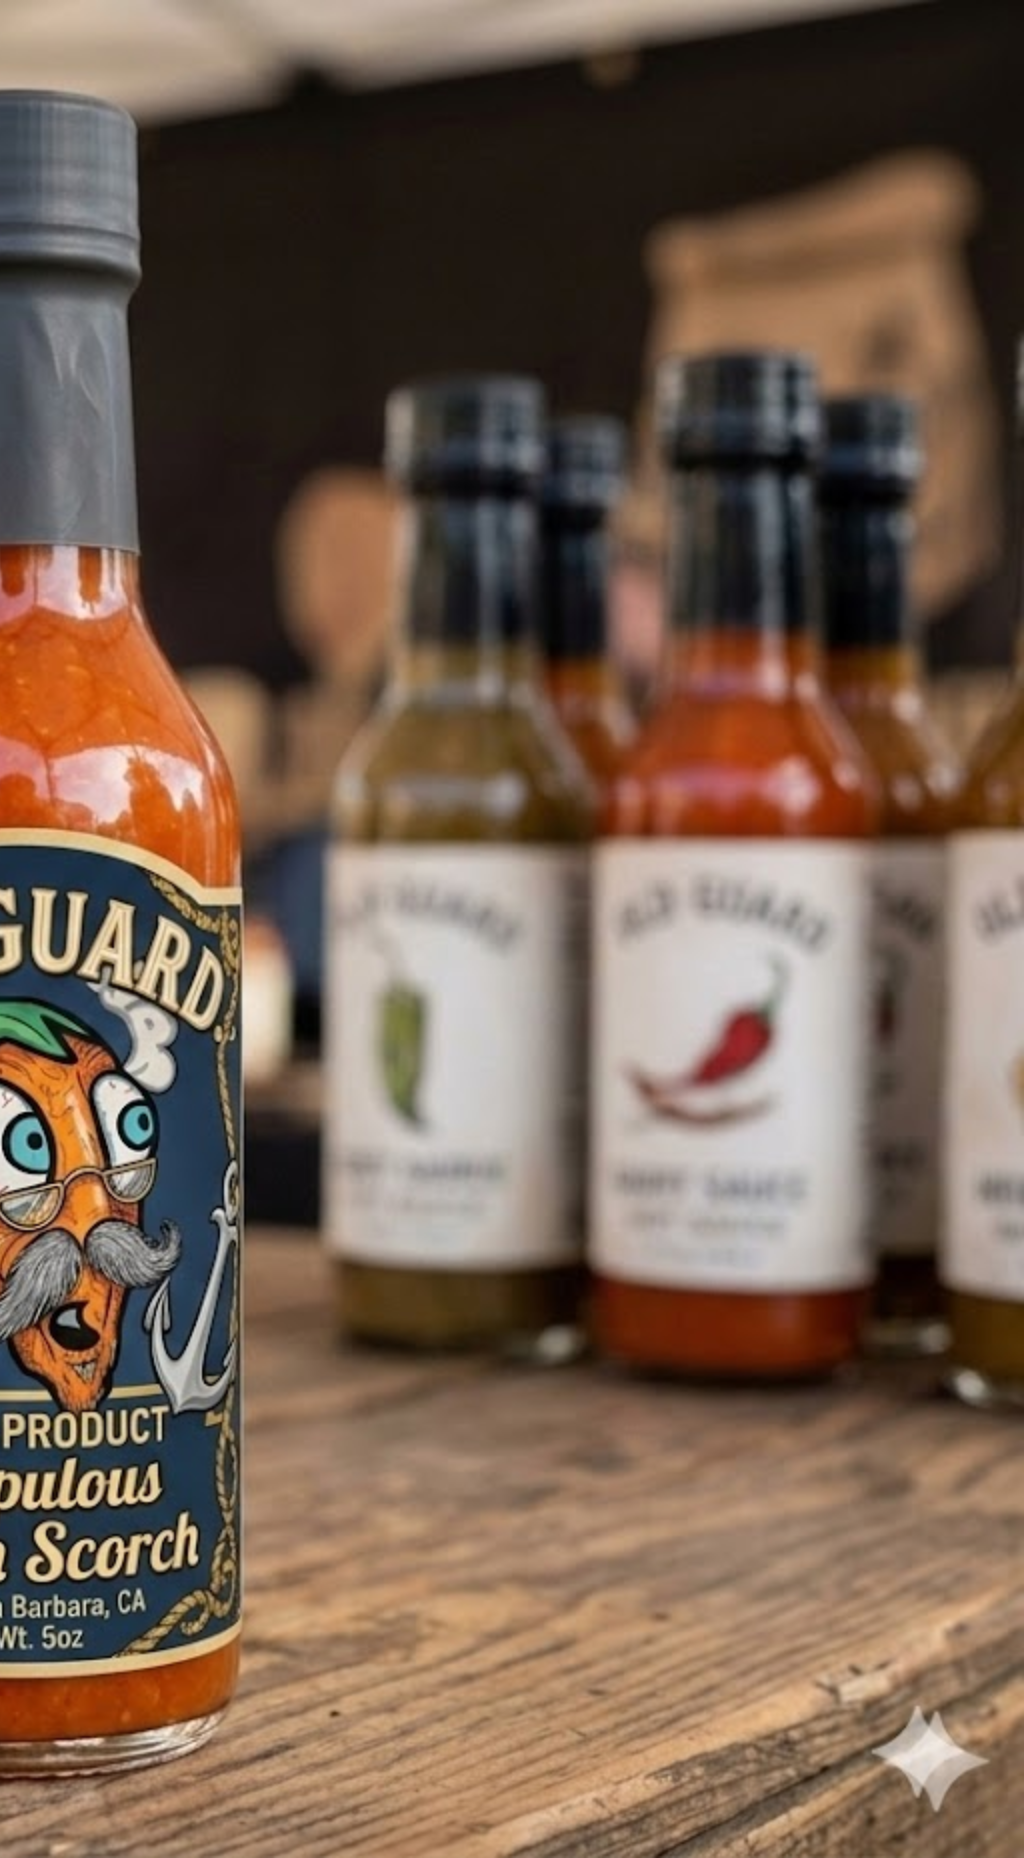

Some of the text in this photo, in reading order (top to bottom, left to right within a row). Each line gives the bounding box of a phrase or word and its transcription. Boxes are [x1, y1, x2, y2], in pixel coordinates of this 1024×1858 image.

[2, 1405, 169, 1449] PRODUCT
[25, 1511, 199, 1583] Scorch
[12, 1592, 110, 1620] Barbara,
[117, 1588, 146, 1613] CA
[41, 1625, 84, 1650] 5oz
